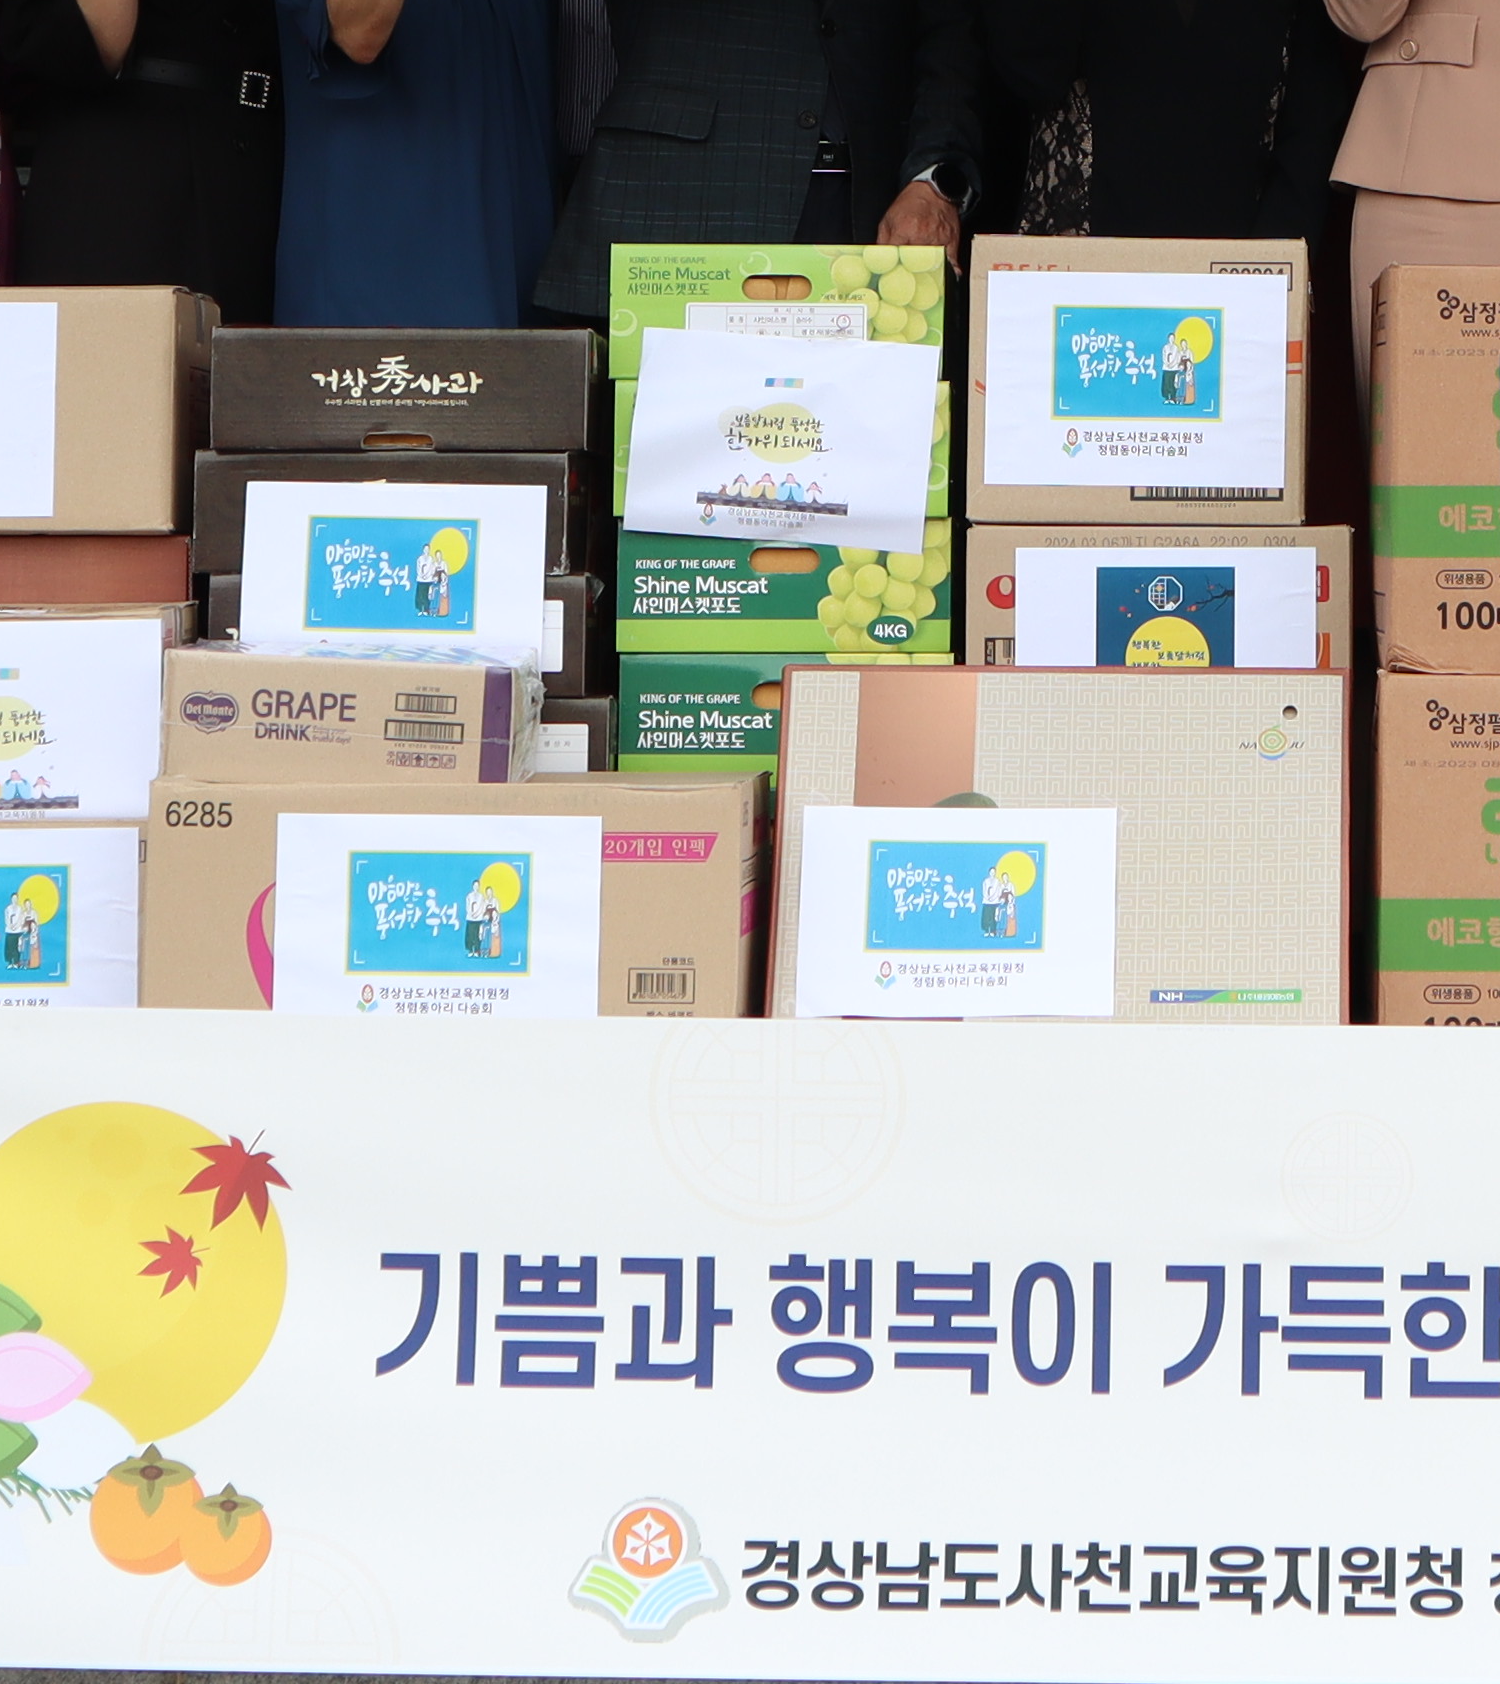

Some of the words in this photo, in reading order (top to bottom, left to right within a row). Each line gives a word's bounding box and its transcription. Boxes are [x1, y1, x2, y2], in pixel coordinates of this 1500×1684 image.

[628, 267, 671, 280] Shine
[675, 267, 731, 281] Muscat
[1125, 340, 1156, 385] 추석
[635, 559, 661, 569] KING
[664, 559, 678, 569] OF
[680, 559, 699, 569] THE
[702, 559, 736, 569] GRAPE
[633, 575, 691, 594] Shine
[695, 576, 769, 595] Muscat
[1443, 573, 1485, 585] 위생용품
[873, 623, 907, 638] 4KG
[251, 689, 358, 722] GRAPE
[639, 694, 666, 704] KING
[668, 694, 682, 704] OF
[684, 694, 704, 704] THE
[706, 694, 741, 704] GRAPE
[638, 710, 695, 729] Shine
[699, 711, 773, 729] Muscat
[254, 722, 312, 742] DRINK
[165, 801, 233, 828] 6285
[1158, 992, 1183, 1001] NH
[1431, 988, 1473, 1000] 위생용품
[373, 1252, 733, 1394] 기쁨과
[766, 1253, 1115, 1396] 행복이
[740, 1536, 1466, 1618] 경상남도사천교육지원청
